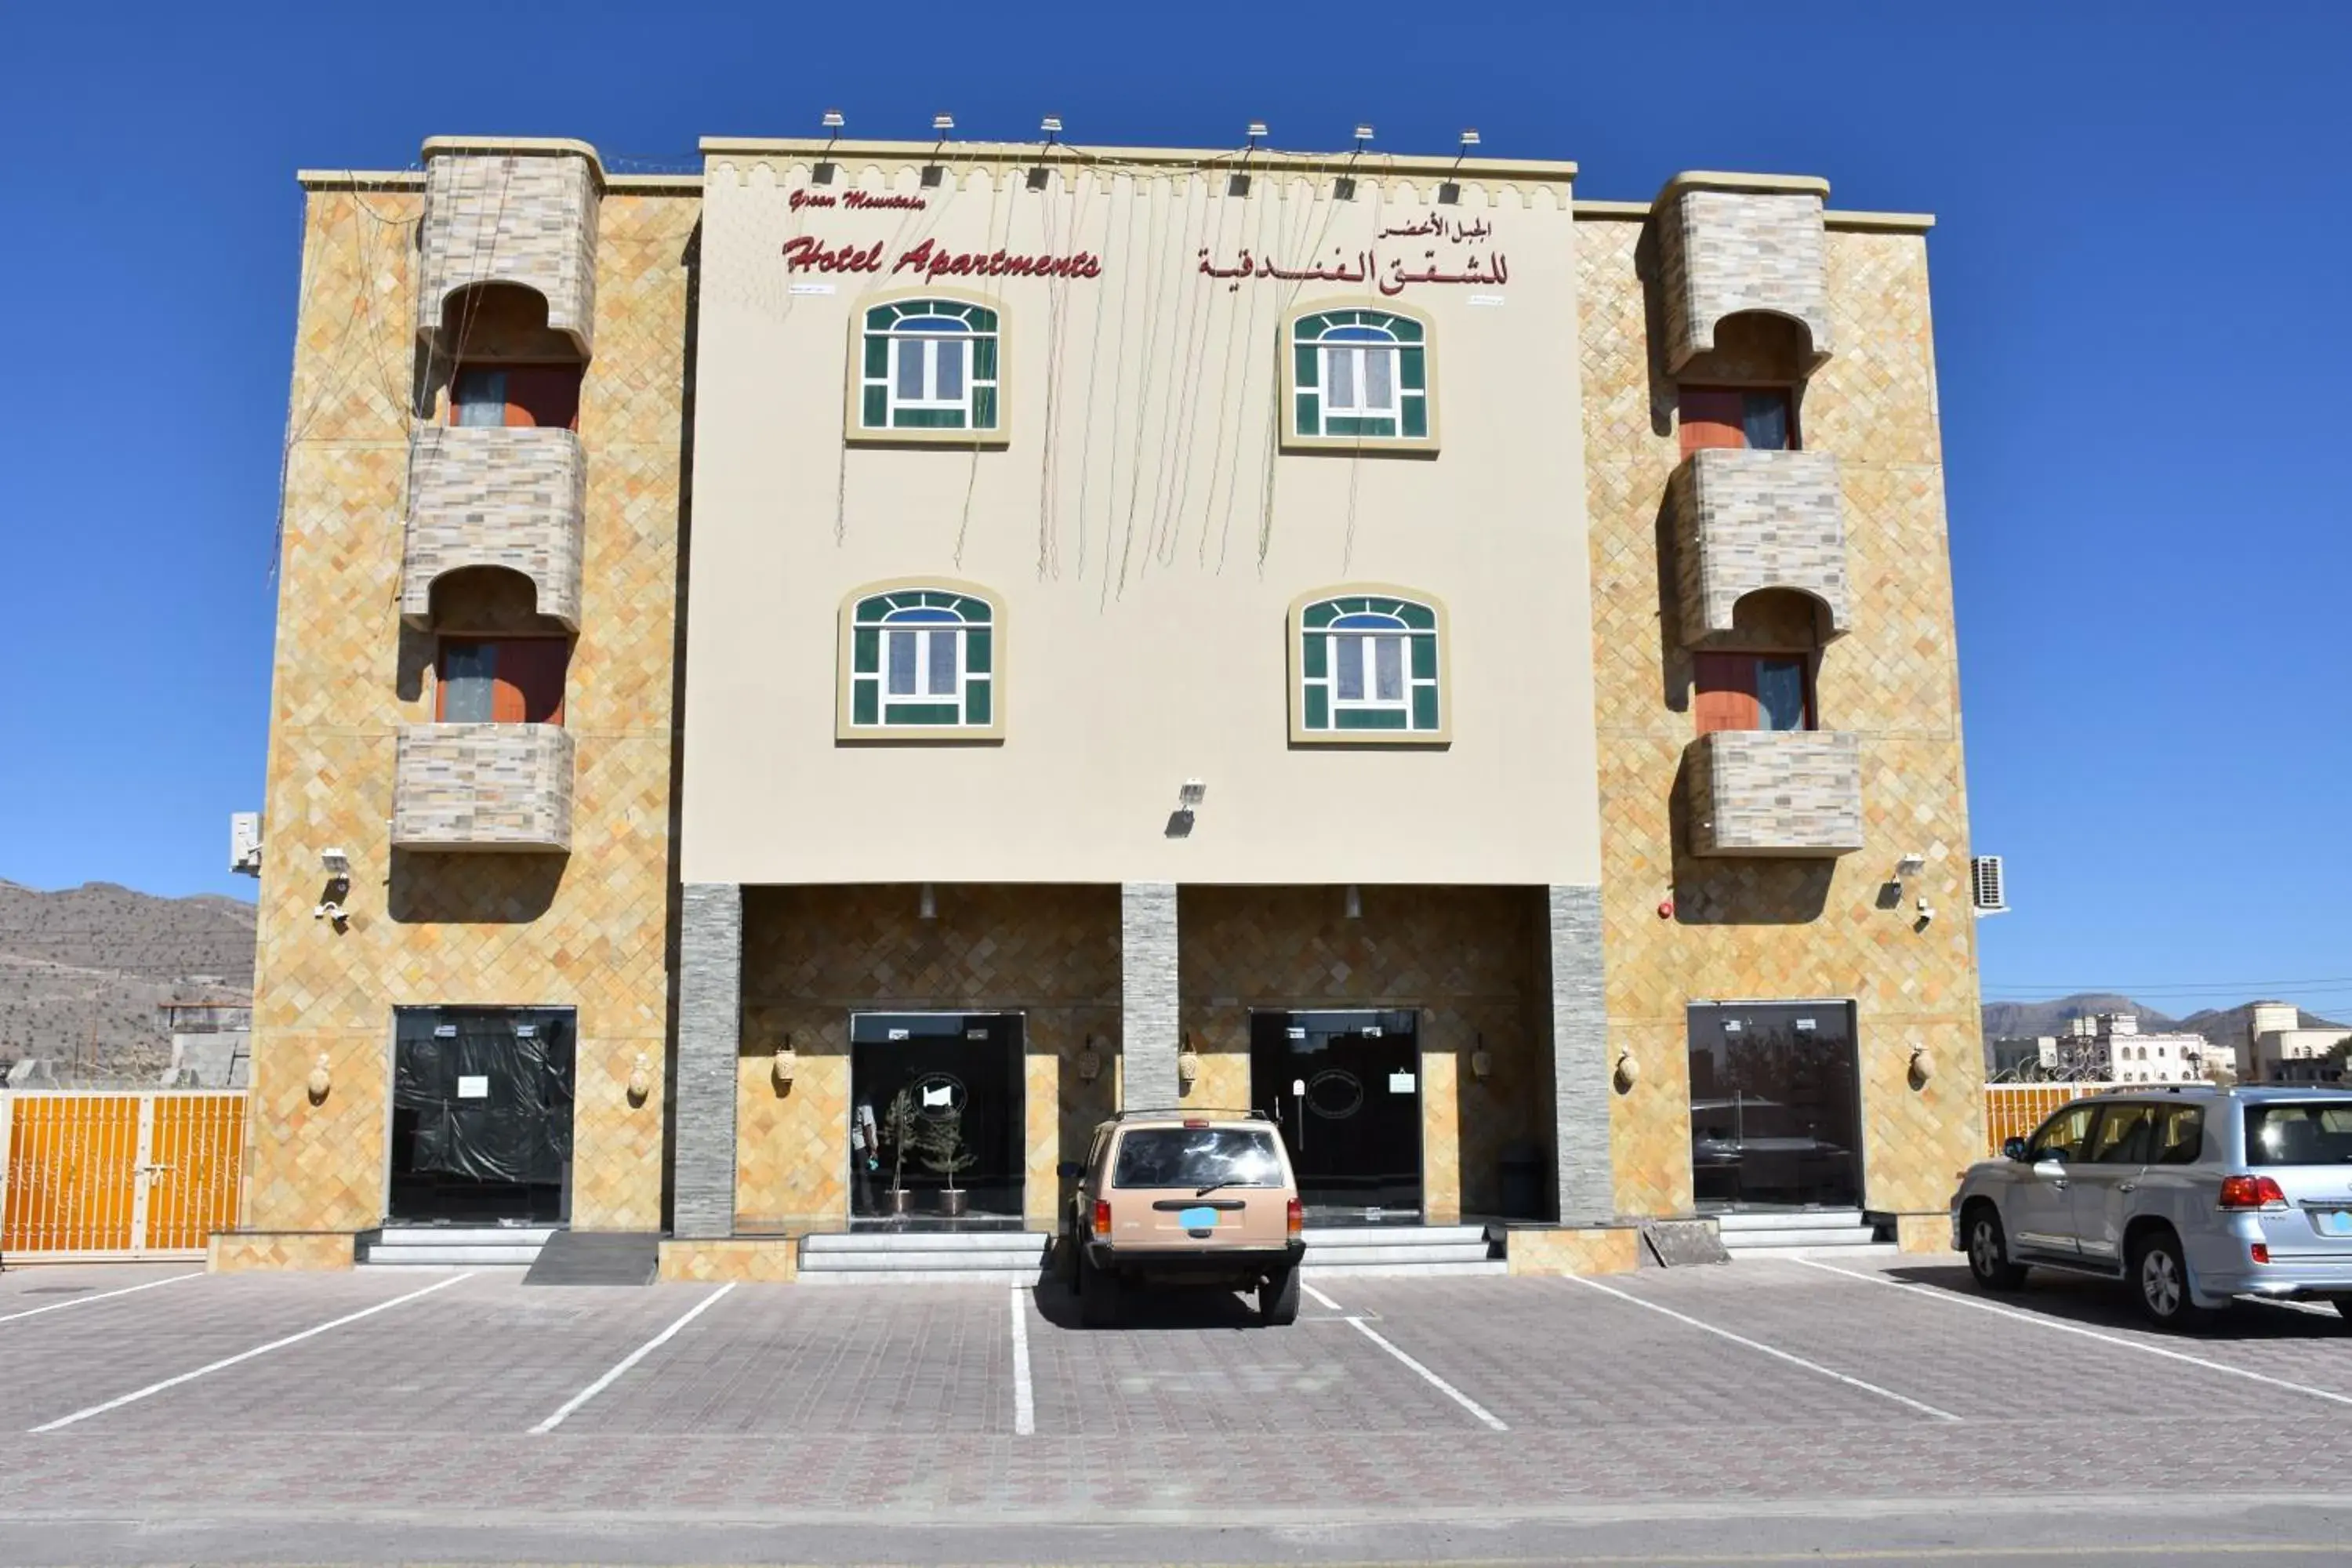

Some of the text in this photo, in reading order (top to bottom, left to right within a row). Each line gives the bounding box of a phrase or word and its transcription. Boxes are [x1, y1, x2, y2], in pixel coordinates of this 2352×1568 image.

[789, 189, 926, 212] Green Mountain
[1378, 211, 1491, 245] الجبل الأخضر
[782, 237, 1102, 285] Hotel Apartments
[1198, 247, 1508, 296] للشقق الفندقية
